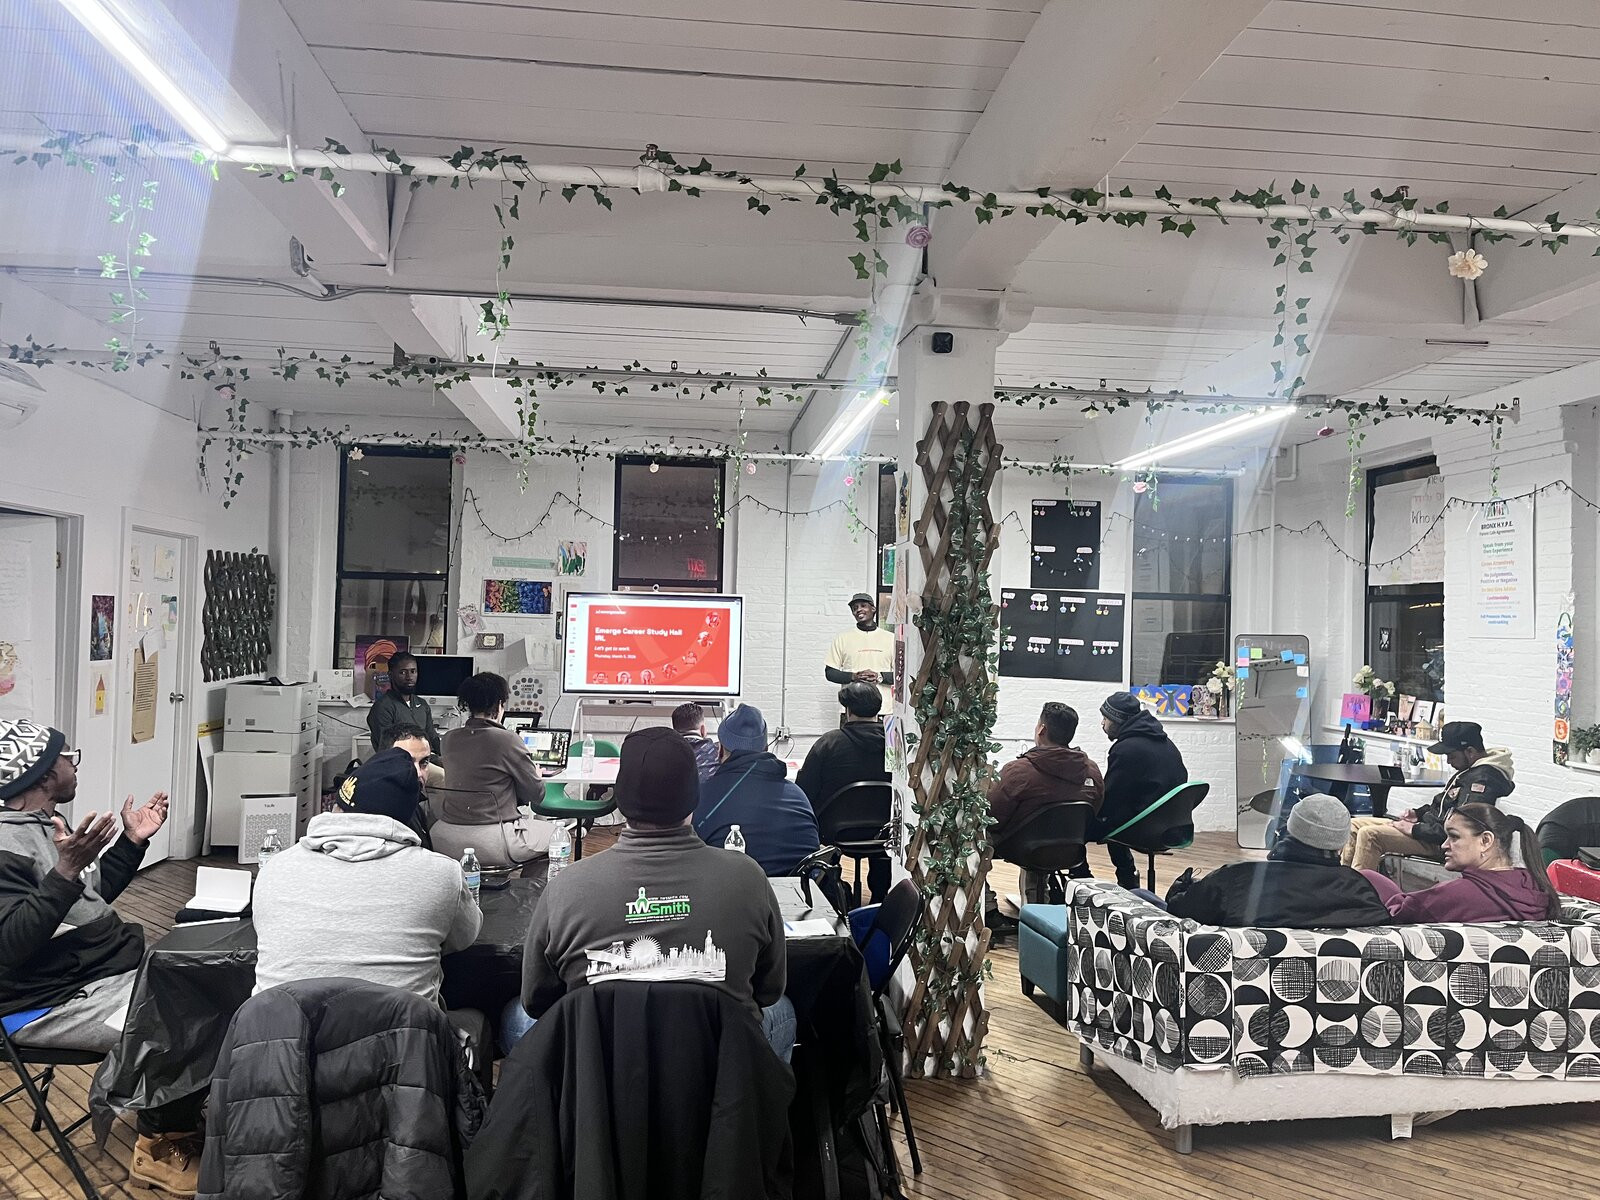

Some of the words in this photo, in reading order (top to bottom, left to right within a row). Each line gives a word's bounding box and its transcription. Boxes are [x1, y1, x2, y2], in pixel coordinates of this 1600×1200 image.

[1411, 511, 1430, 524] Who
[594, 627, 622, 636] Emerge
[646, 629, 669, 637] Study
